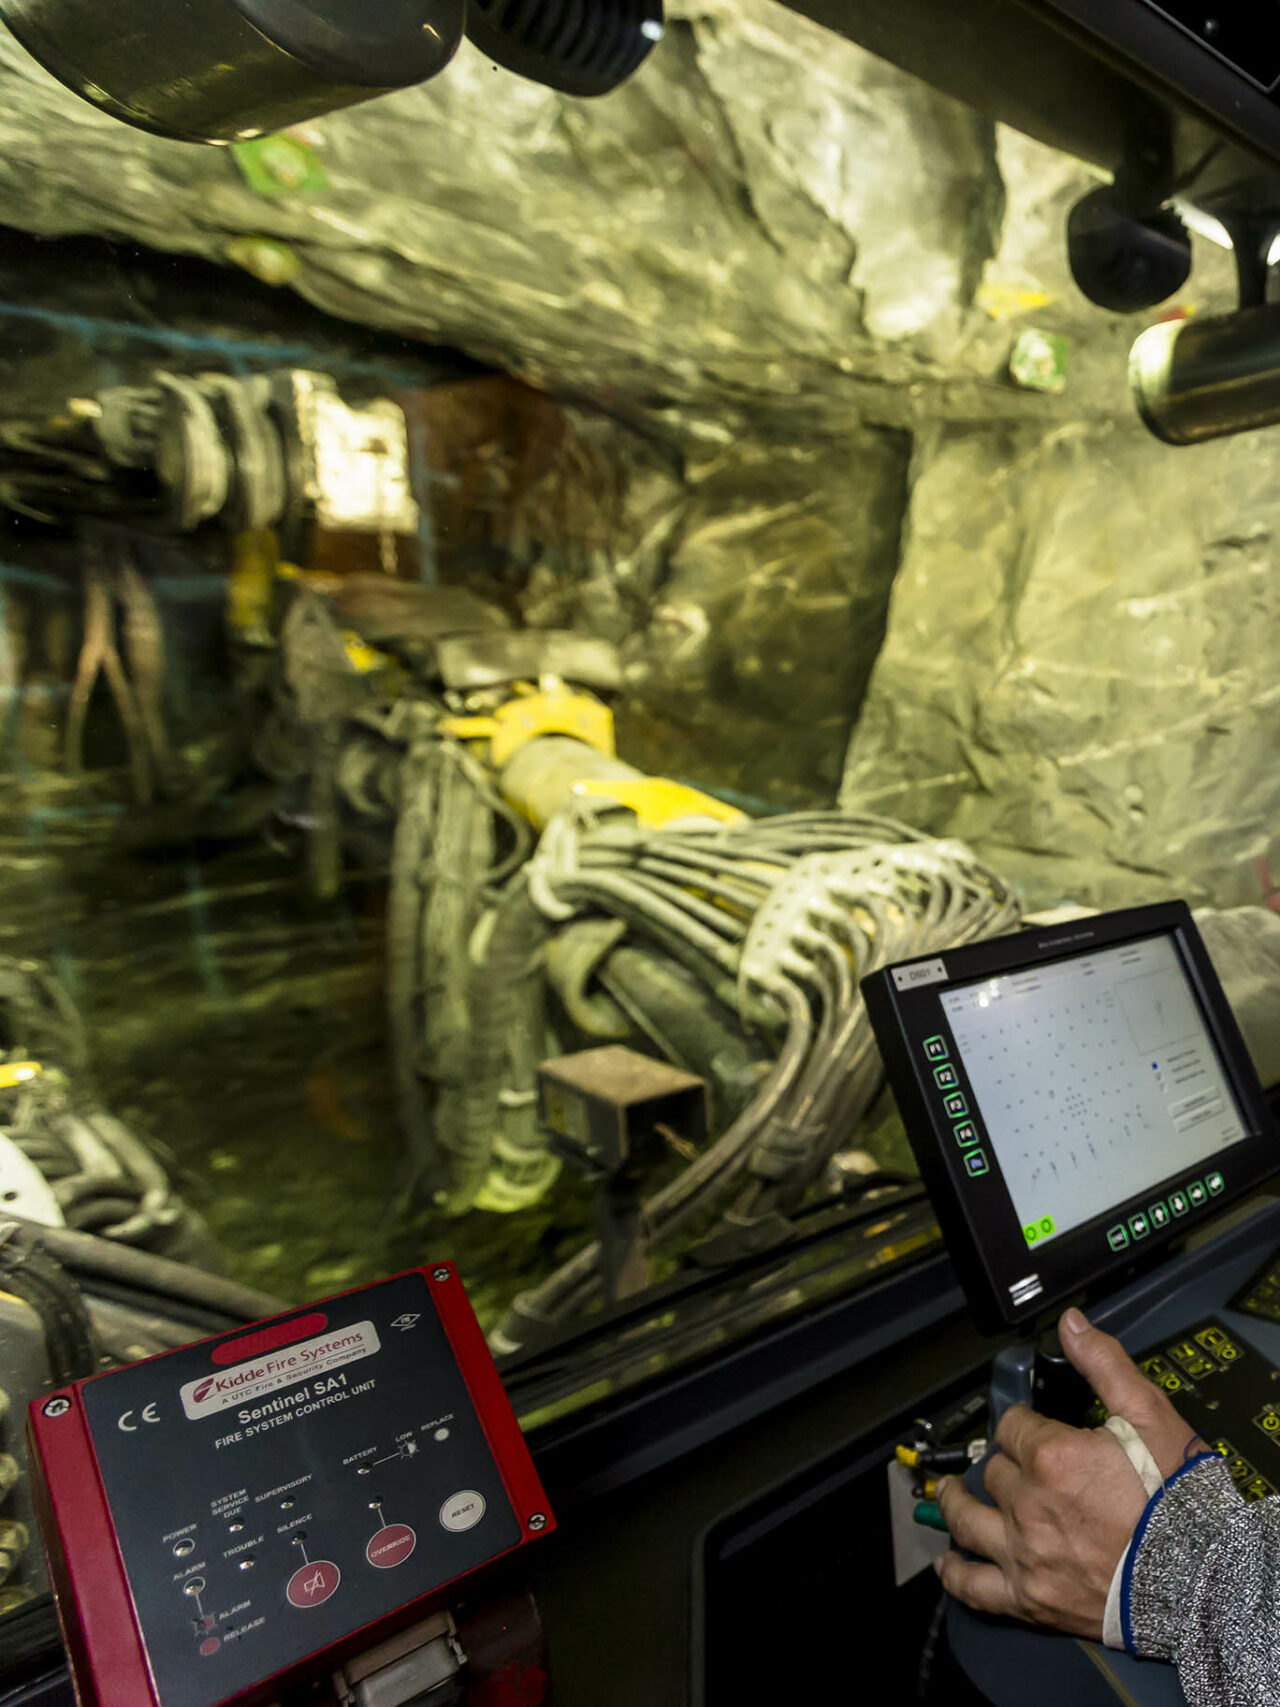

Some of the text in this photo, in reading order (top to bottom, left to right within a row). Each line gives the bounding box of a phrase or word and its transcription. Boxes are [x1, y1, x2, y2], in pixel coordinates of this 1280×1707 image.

[215, 1331, 363, 1393] Kidde Fire Systems
[231, 1389, 252, 1401] UTC
[255, 1382, 274, 1392] Fire
[286, 1363, 324, 1381] Security
[325, 1347, 368, 1370] Company
[238, 1373, 349, 1425] Sentinel SA1
[214, 1379, 378, 1450] FIRE SYSTEM CONTROL UNIT
[420, 1413, 456, 1432] REPLACE
[395, 1431, 413, 1443] LOW
[342, 1446, 378, 1466] BATTERY
[210, 1488, 247, 1509] SYSTEM
[254, 1474, 313, 1504] SUPERVISORY
[211, 1495, 250, 1517] SERVICE
[223, 1506, 243, 1519] DUE
[451, 1503, 476, 1519] RESET
[162, 1523, 198, 1543] POWER
[276, 1513, 313, 1534] SILENCE
[223, 1535, 265, 1558] TROUBLE
[370, 1534, 411, 1558] OVERRIDE
[172, 1561, 207, 1582] ALARM
[218, 1599, 251, 1620] ALARM
[223, 1616, 267, 1642] RELEASE
